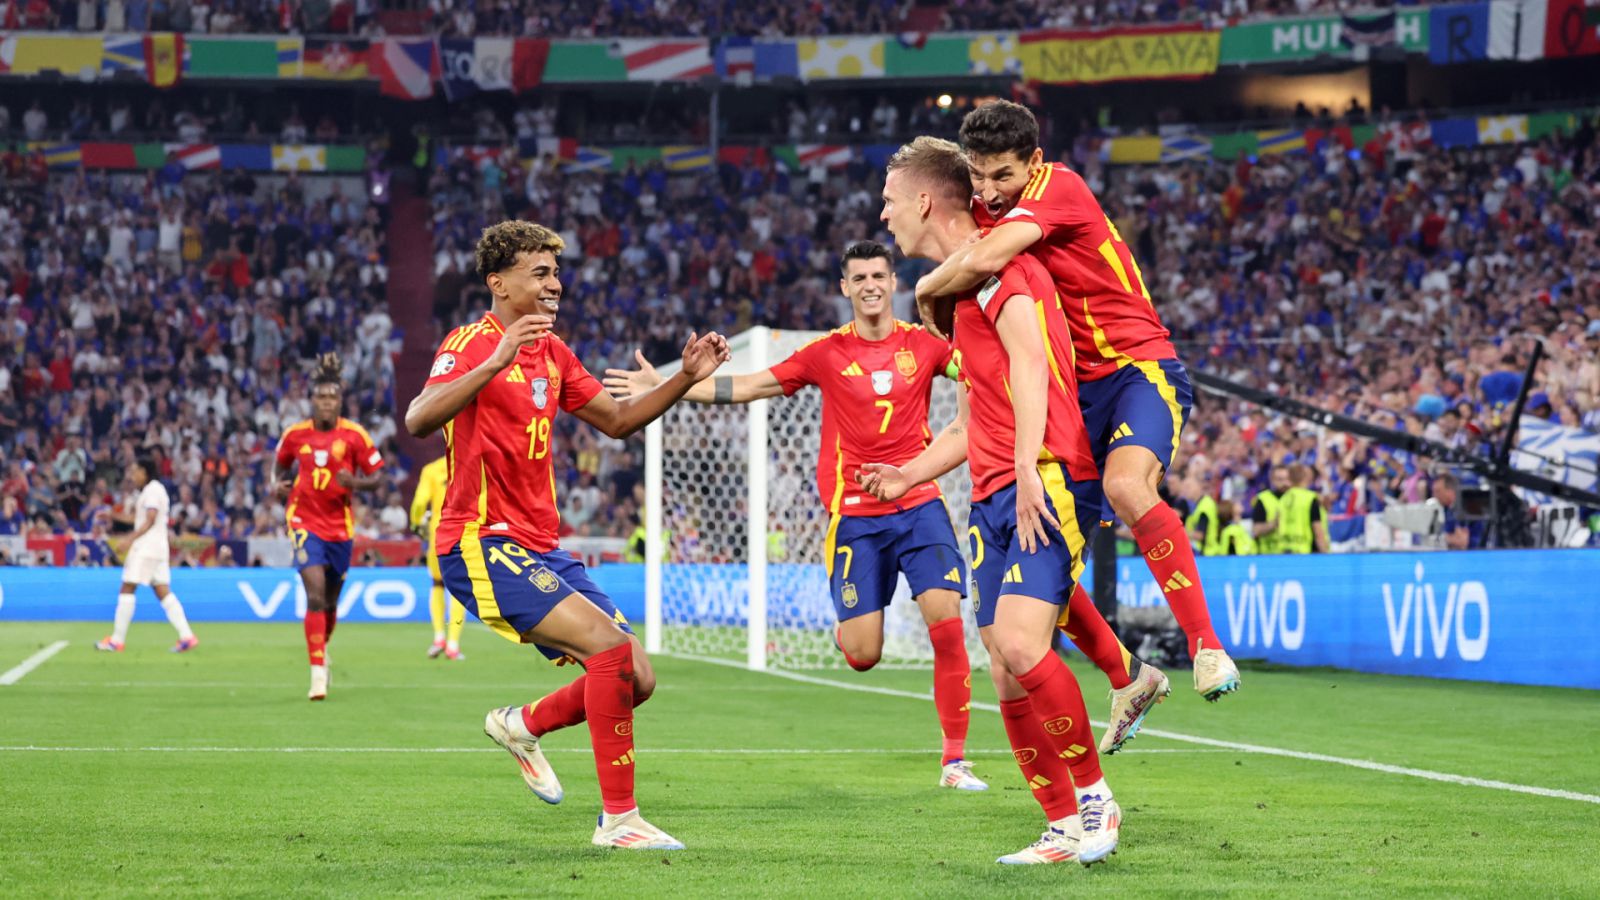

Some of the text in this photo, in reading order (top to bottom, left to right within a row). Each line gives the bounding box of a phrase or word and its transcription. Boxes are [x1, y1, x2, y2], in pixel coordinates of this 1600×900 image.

[1273, 17, 1420, 53] MUNH
[875, 400, 894, 434] 7
[526, 417, 550, 460] 19
[312, 468, 331, 490] 17
[488, 542, 537, 576] 19
[837, 546, 853, 580] 7
[1224, 563, 1306, 650] vivo
[1382, 560, 1490, 662] vivo
